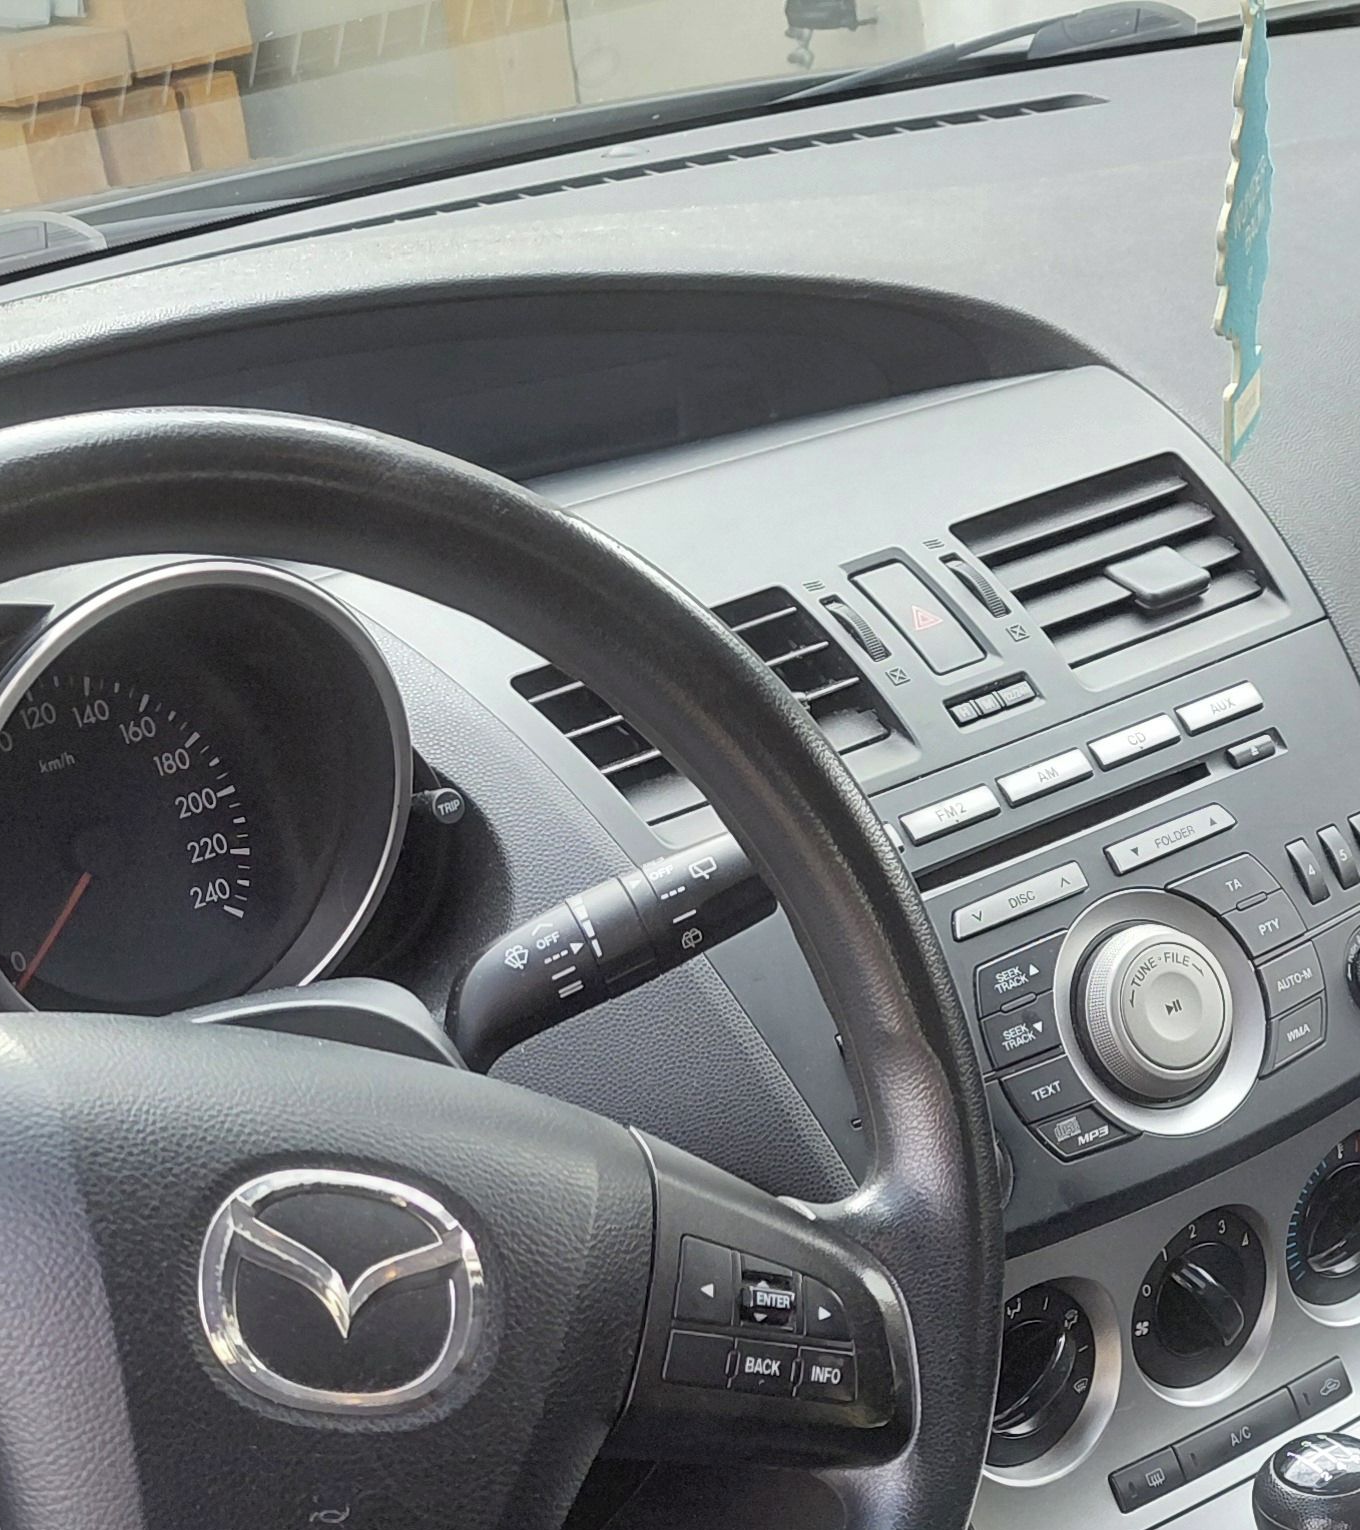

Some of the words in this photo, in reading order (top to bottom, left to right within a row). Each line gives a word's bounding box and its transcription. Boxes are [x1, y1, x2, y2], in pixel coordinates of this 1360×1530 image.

[72, 699, 110, 728] 140
[1210, 696, 1238, 716] AUX
[20, 703, 57, 731] 120
[119, 716, 156, 746] 160
[1126, 731, 1147, 748] CD
[39, 751, 76, 774] km/h
[153, 747, 190, 777] 180
[1036, 766, 1060, 784] AM
[175, 787, 217, 820] 200
[437, 798, 461, 815] TRIP
[935, 800, 968, 823] FM2
[1153, 823, 1196, 849] FOLDER
[186, 832, 228, 864] 220
[1340, 850, 1348, 862] 5
[1308, 864, 1316, 876] 4
[190, 878, 231, 910] 240
[1225, 878, 1243, 892] TA
[1007, 889, 1036, 909] DISC
[1258, 918, 1280, 936] PTY
[535, 931, 561, 950] OFF
[11, 950, 27, 972] 0
[995, 965, 1022, 983] SEEK
[1276, 967, 1313, 992] AUTO-M
[994, 976, 1029, 994] TRACK
[1001, 1031, 1037, 1051] TRACK
[1002, 1022, 1029, 1040] SEEK
[1286, 1024, 1311, 1042] WMA
[1031, 1080, 1062, 1101] TEXT
[1077, 1125, 1110, 1147] MP3
[1188, 1223, 1198, 1239] 2
[1217, 1219, 1226, 1234] 3
[1241, 1231, 1249, 1247] 4
[756, 1292, 791, 1309] ENTER
[1141, 1284, 1152, 1297] 0
[744, 1356, 780, 1377] BACK
[810, 1364, 841, 1385] INFO
[1229, 1426, 1252, 1447] A/C
